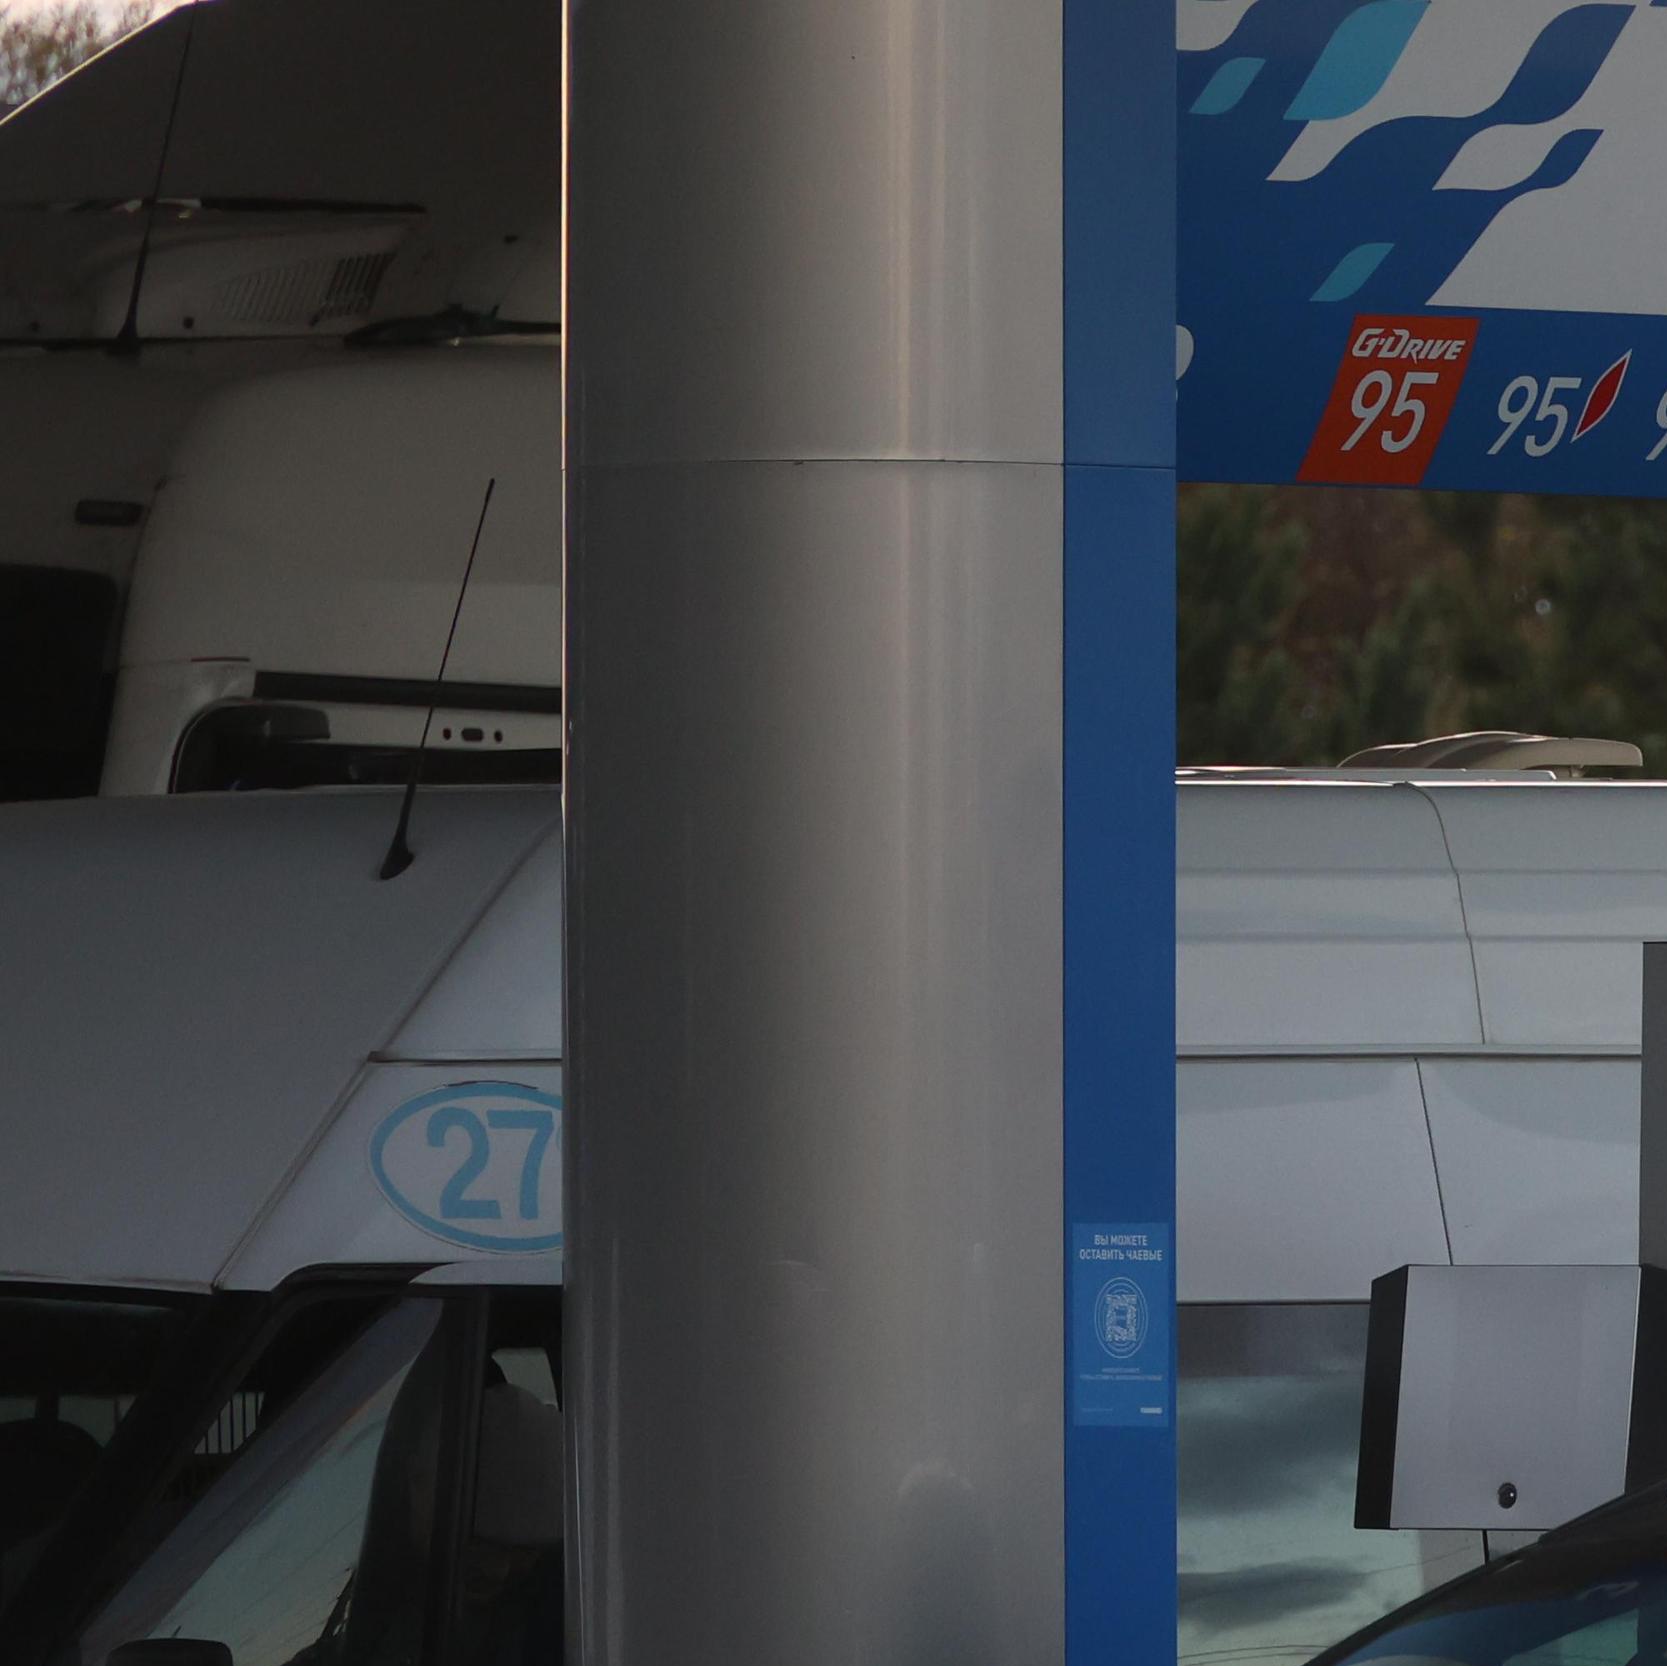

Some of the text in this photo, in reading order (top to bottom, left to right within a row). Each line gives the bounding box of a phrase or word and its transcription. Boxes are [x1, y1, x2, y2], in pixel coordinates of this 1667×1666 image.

[1341, 371, 1439, 454] 95
[1487, 375, 1582, 458] 95
[1093, 1234, 1148, 1247] ВЫ МОЖЕТЕ
[1079, 1248, 1163, 1262] ОСТАВИТЬ ЧАЕВЫЕ
